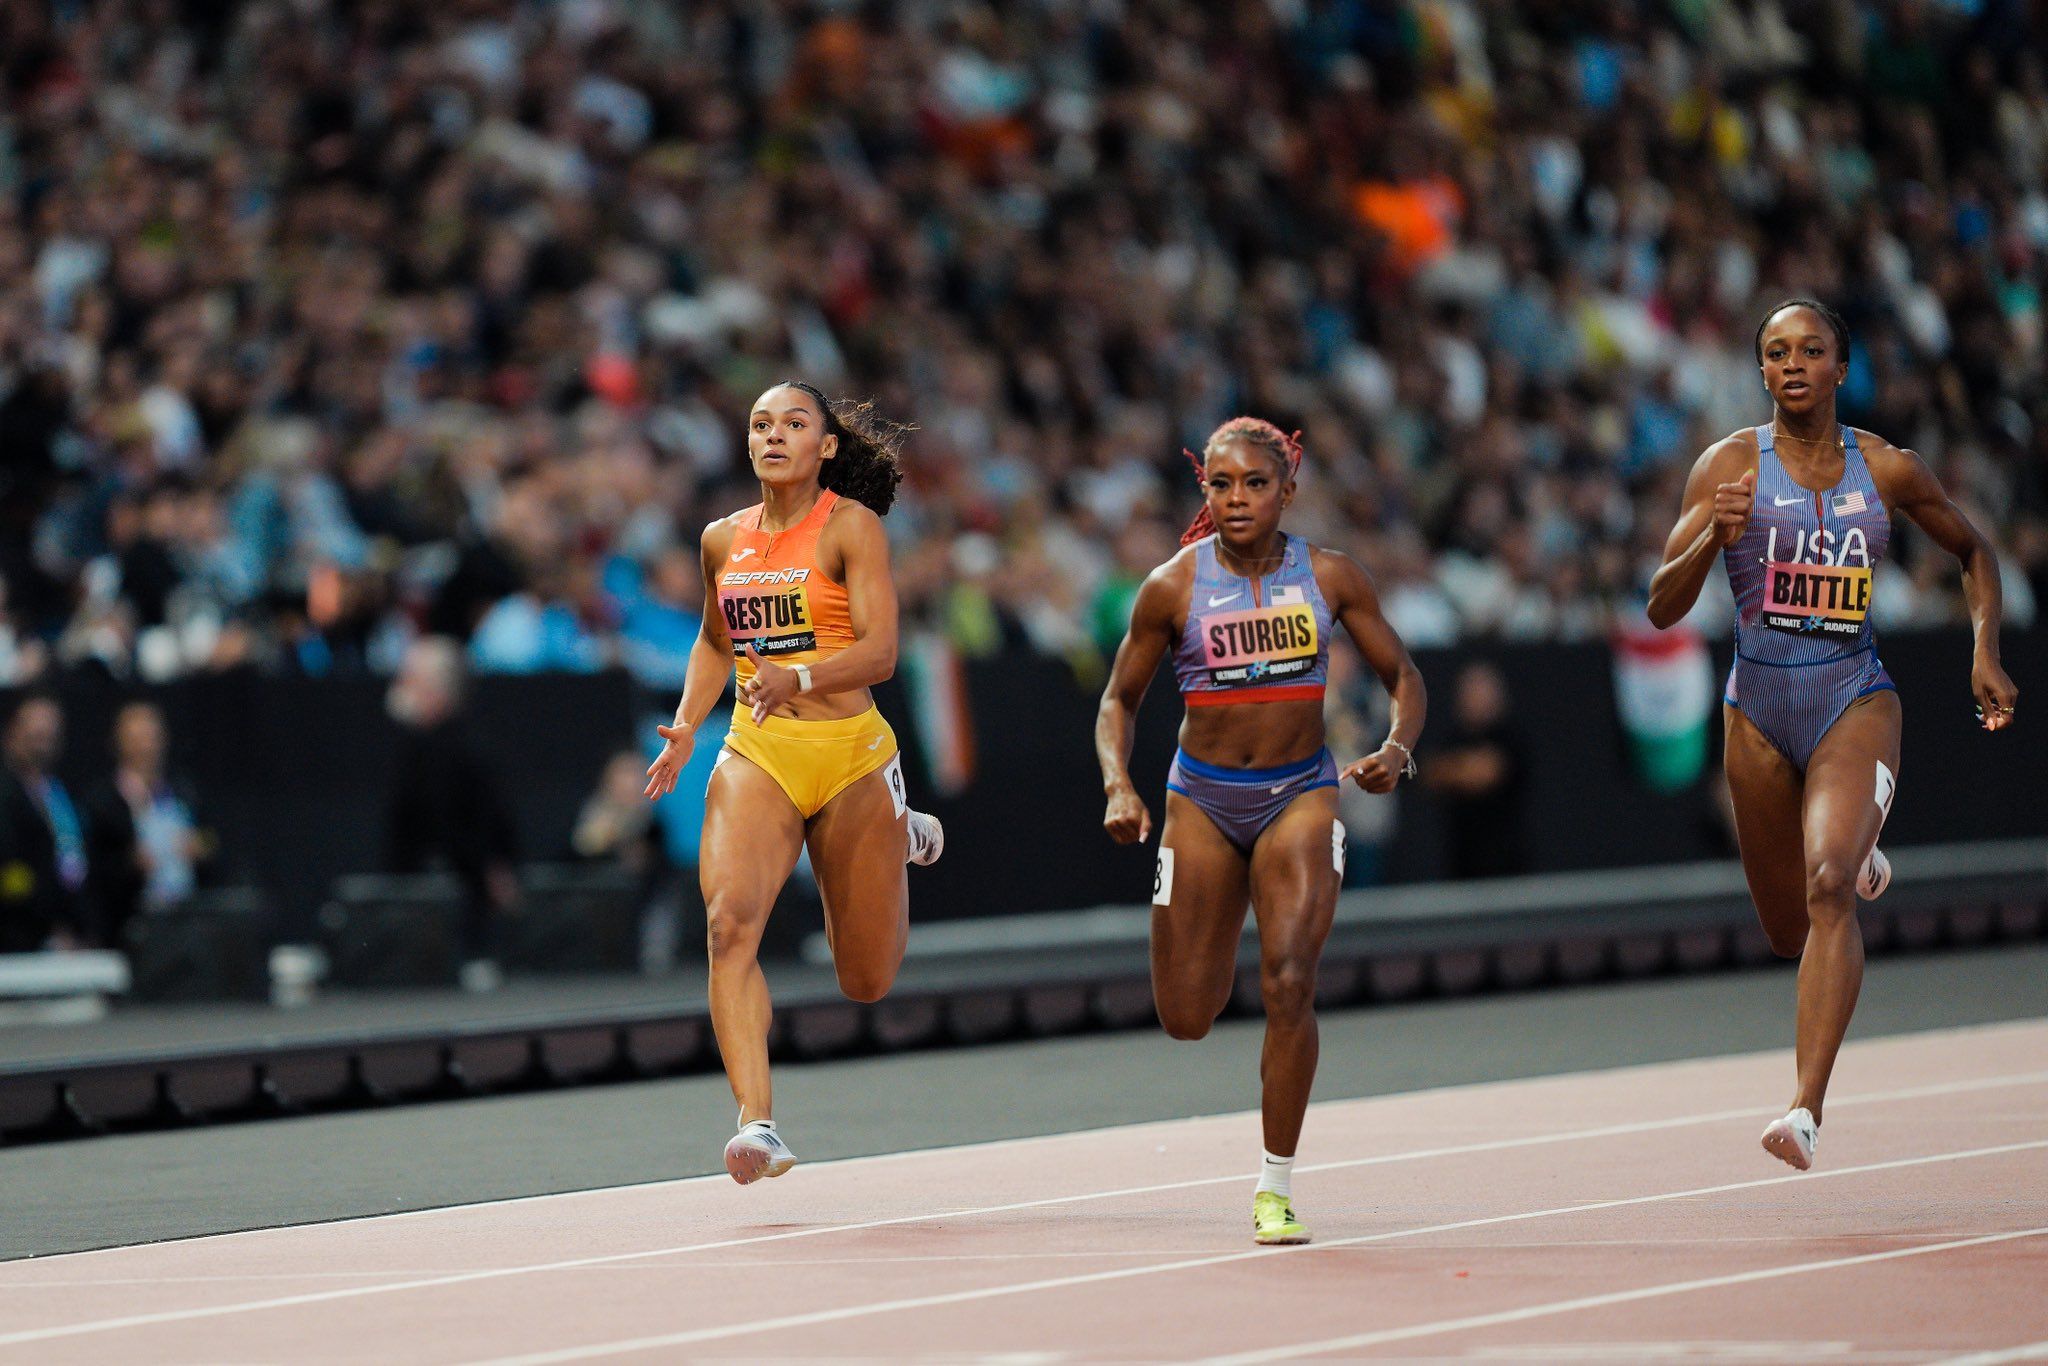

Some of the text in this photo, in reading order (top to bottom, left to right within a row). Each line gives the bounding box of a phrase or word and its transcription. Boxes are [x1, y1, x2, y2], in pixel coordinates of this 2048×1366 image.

[1768, 526, 1869, 568] USA
[721, 567, 811, 586] ESPAÑA
[1772, 570, 1868, 612] BATTLE
[723, 587, 806, 631] BESTUÉ
[1769, 616, 1860, 634] ULTIMATE BUDAPEST
[768, 638, 800, 650] BUDAPEST
[1209, 614, 1311, 659] STURGIS
